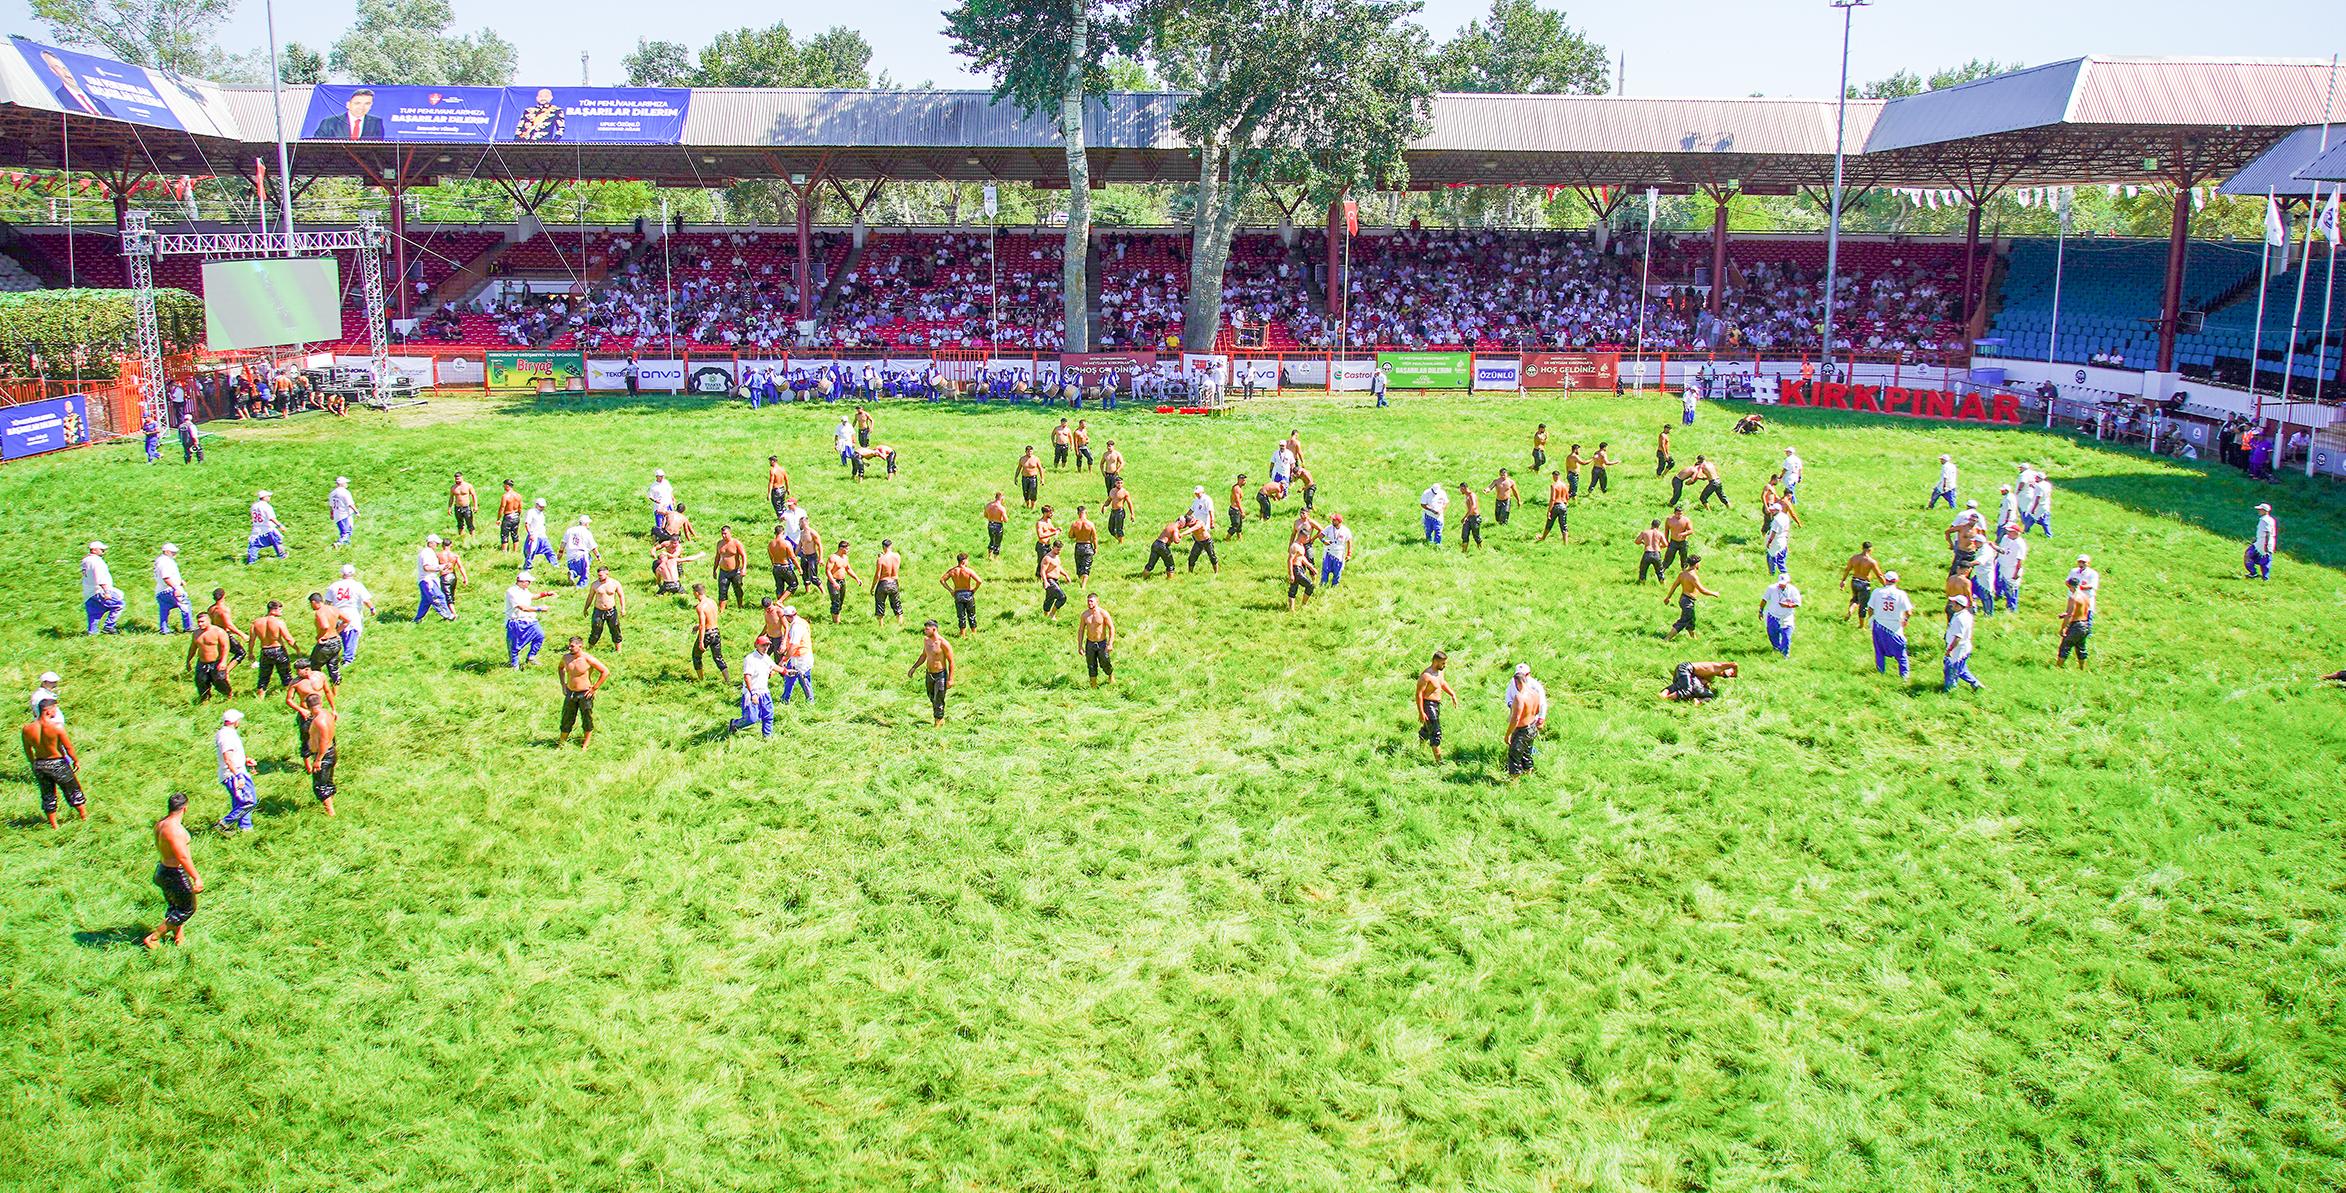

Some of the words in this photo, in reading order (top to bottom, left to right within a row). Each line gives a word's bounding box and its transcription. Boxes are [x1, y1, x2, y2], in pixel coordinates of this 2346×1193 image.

[566, 107, 630, 117] BAŞARILAR
[516, 358, 553, 375] Biryağ
[1080, 366, 1097, 375] HOŞ
[1540, 366, 1558, 374] HOŞ
[1559, 365, 1596, 373] GELDİNİZ
[1344, 371, 1372, 379] Castrol
[1479, 371, 1514, 379] ÖZÜNLÜ
[337, 587, 350, 600] 54
[1882, 601, 1895, 612] 35
